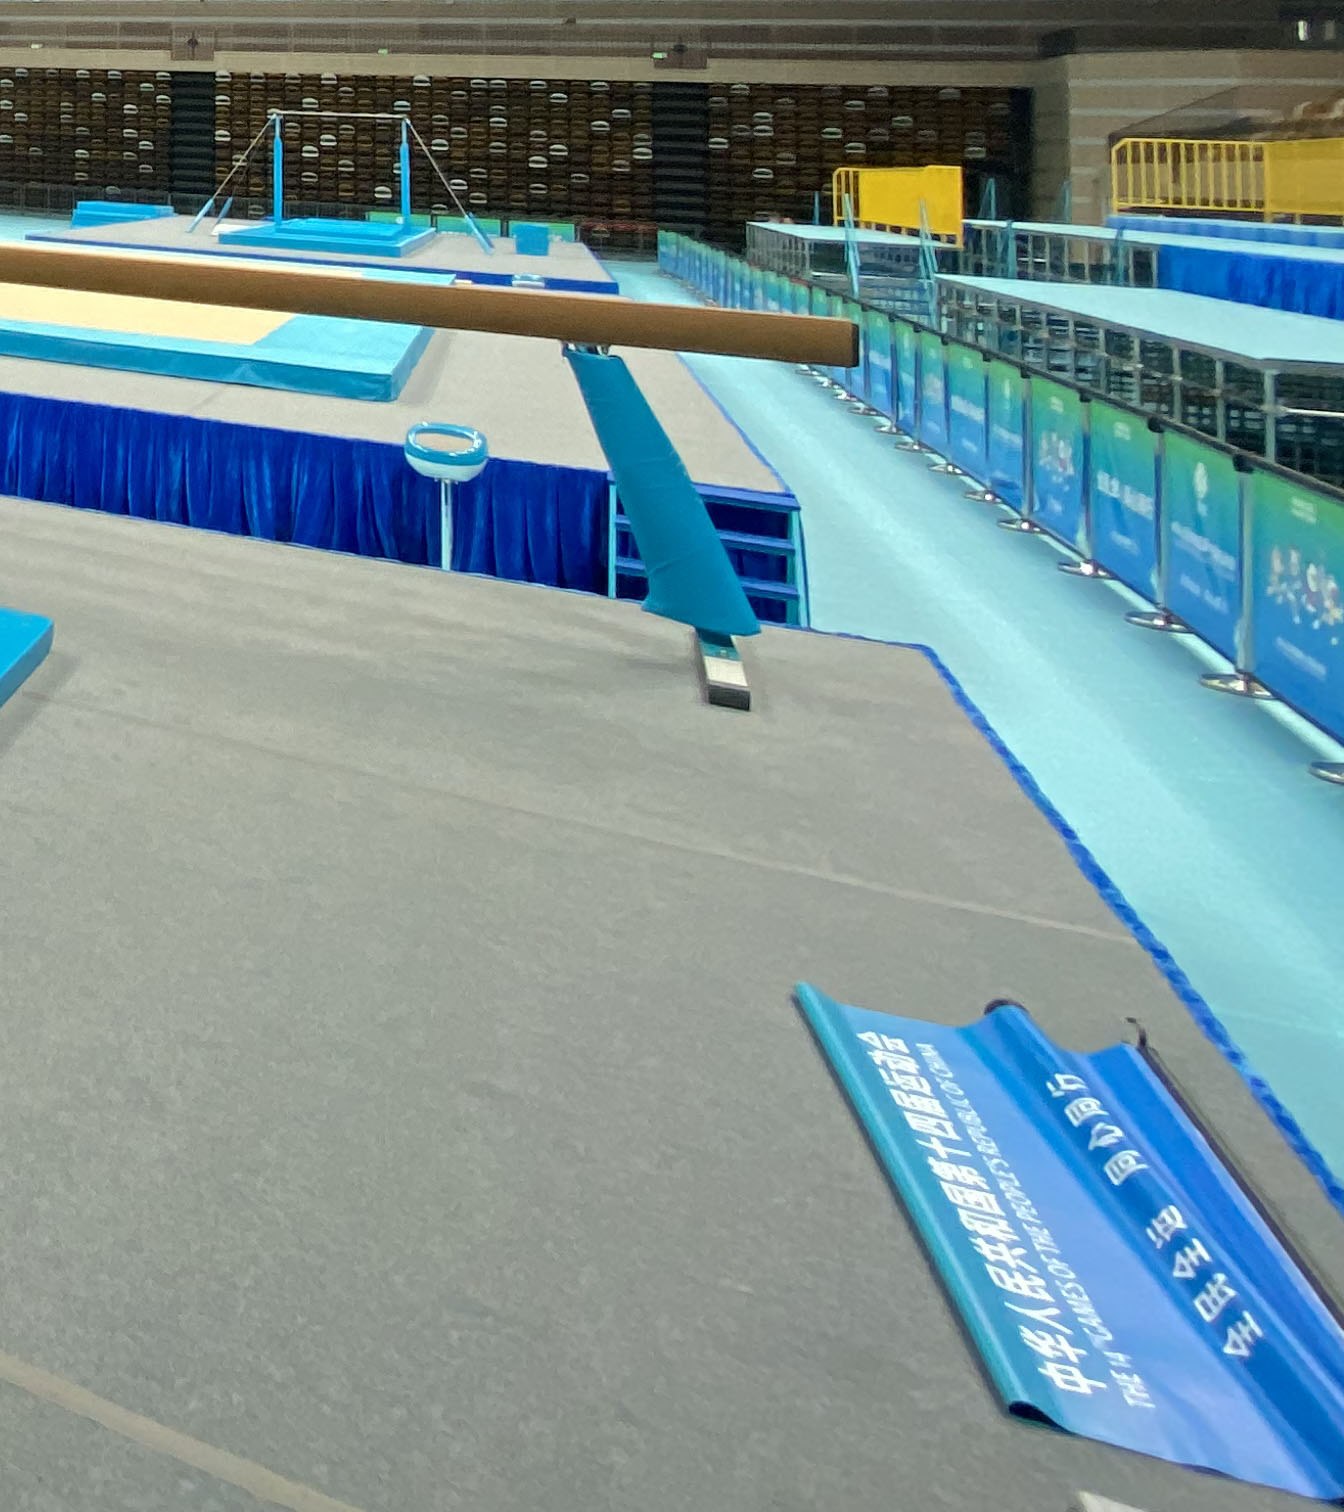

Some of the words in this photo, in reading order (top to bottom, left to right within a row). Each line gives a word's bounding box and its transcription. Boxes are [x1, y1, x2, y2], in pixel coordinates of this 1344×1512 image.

[934, 1076, 964, 1096] OF
[944, 1092, 1002, 1157] REPUBLIC
[1046, 1073, 1149, 1186] 同心同行
[856, 1031, 1107, 1395] 中华人民共和国第十四届运动会
[1022, 1221, 1061, 1254] THE
[1040, 1254, 1076, 1279] OF
[1146, 1205, 1263, 1357] 全民全运
[1055, 1281, 1113, 1341] GAMES
[1109, 1369, 1156, 1408] THE
